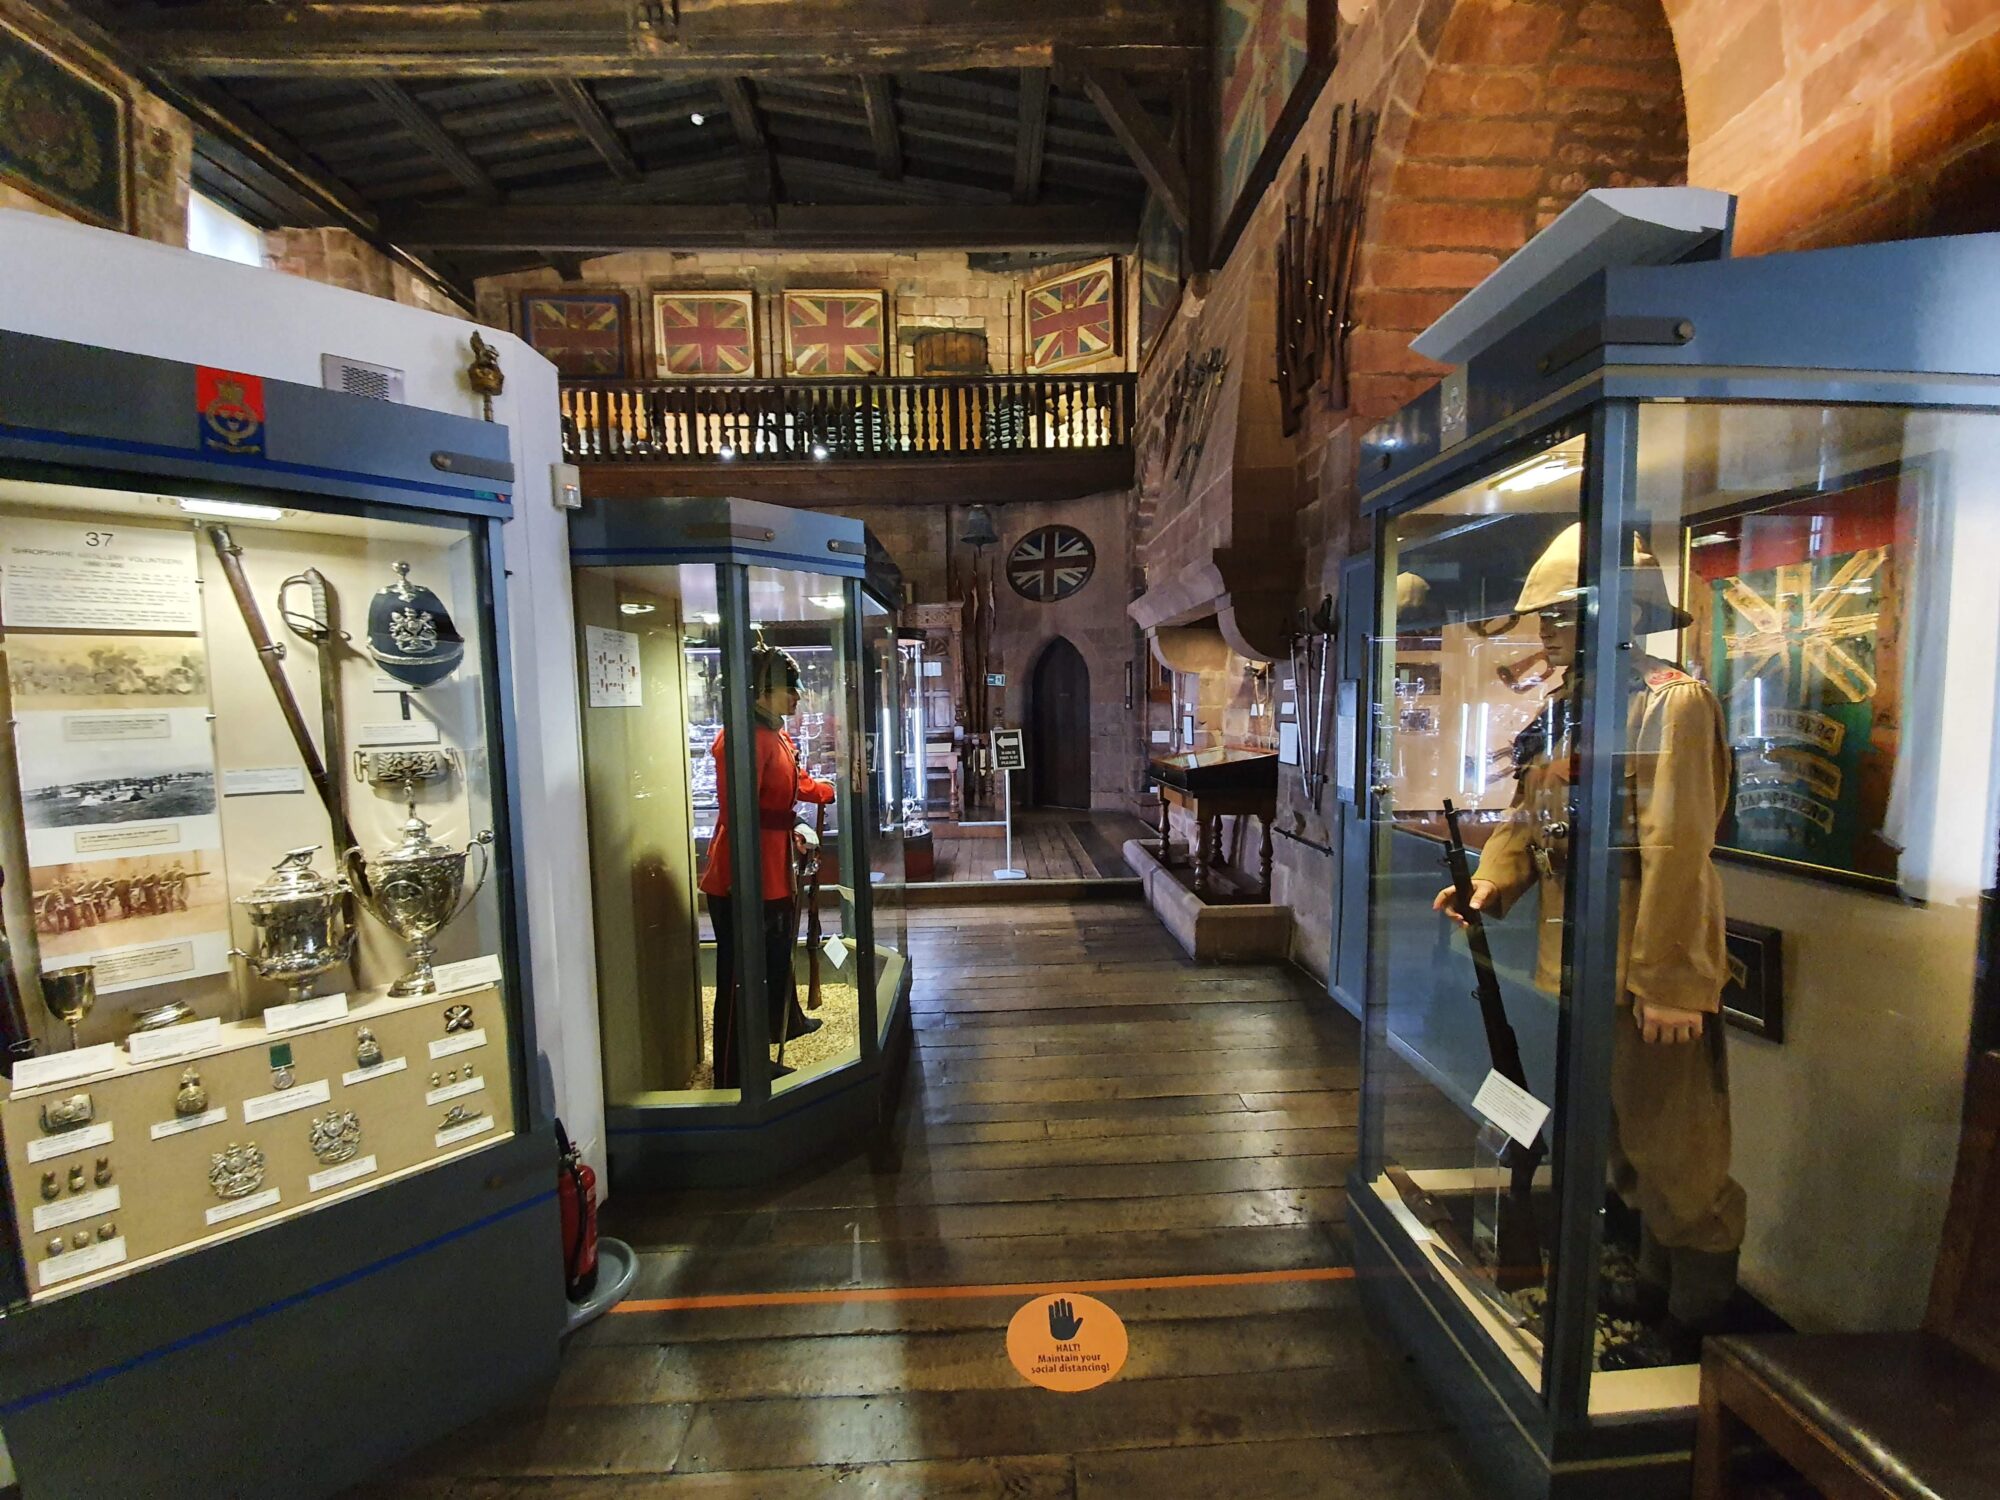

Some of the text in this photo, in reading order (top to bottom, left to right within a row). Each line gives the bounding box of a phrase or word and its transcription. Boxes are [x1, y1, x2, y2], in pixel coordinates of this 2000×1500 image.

[86, 532, 114, 547] 37
[11, 547, 74, 558] SHROPSHIRE
[1056, 1343, 1081, 1352] HALT!
[1038, 1353, 1101, 1363] Maintain your
[1031, 1363, 1110, 1374] social distancing!
